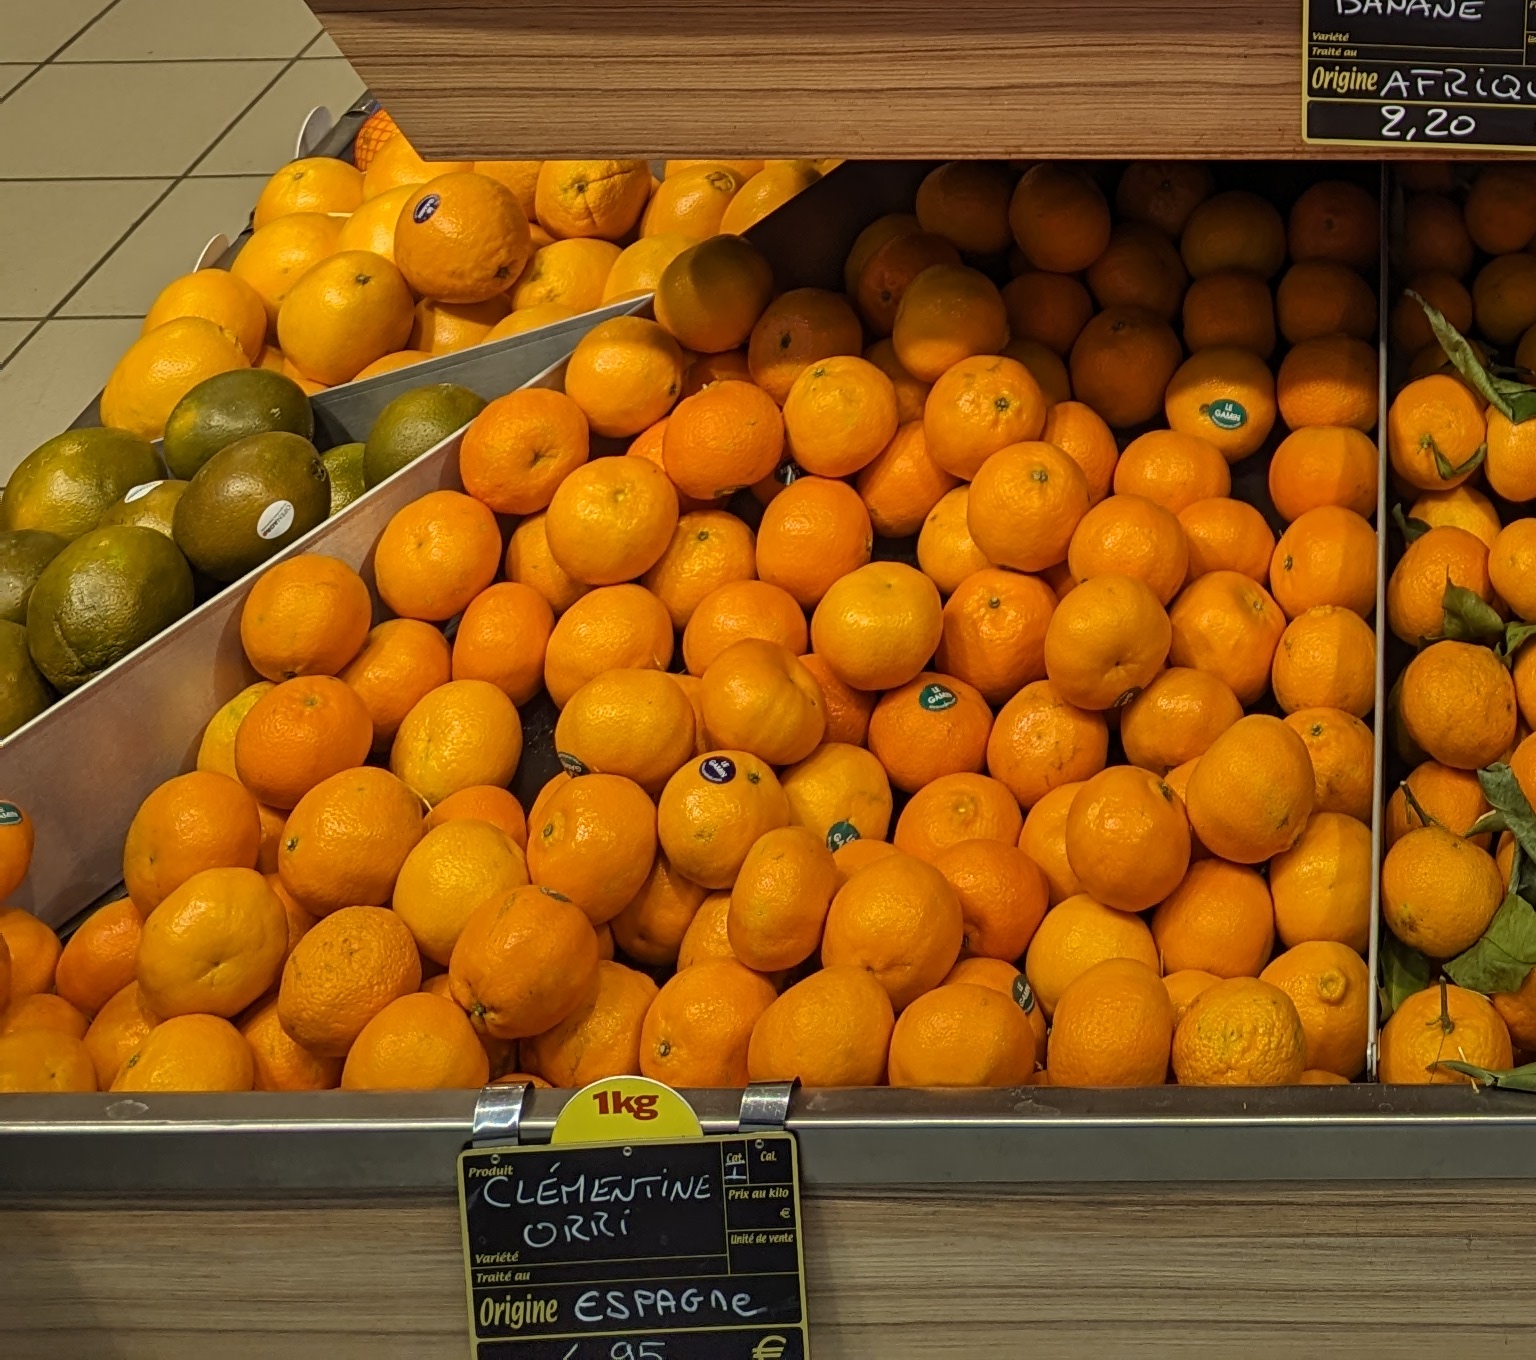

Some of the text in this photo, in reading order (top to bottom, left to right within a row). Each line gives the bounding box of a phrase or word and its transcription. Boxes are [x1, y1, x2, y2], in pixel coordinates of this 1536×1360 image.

[1312, 31, 1350, 43] Variété
[1311, 65, 1378, 93] Origine
[592, 1089, 660, 1121] 1kg
[468, 1164, 514, 1178] Produit
[728, 1187, 789, 1201] Prix au kilo
[730, 1232, 794, 1245] Unité de vente
[475, 1250, 519, 1264] Variété
[475, 1270, 531, 1283] Traité au
[479, 1294, 558, 1330] Origine
[751, 1335, 787, 1360] €
